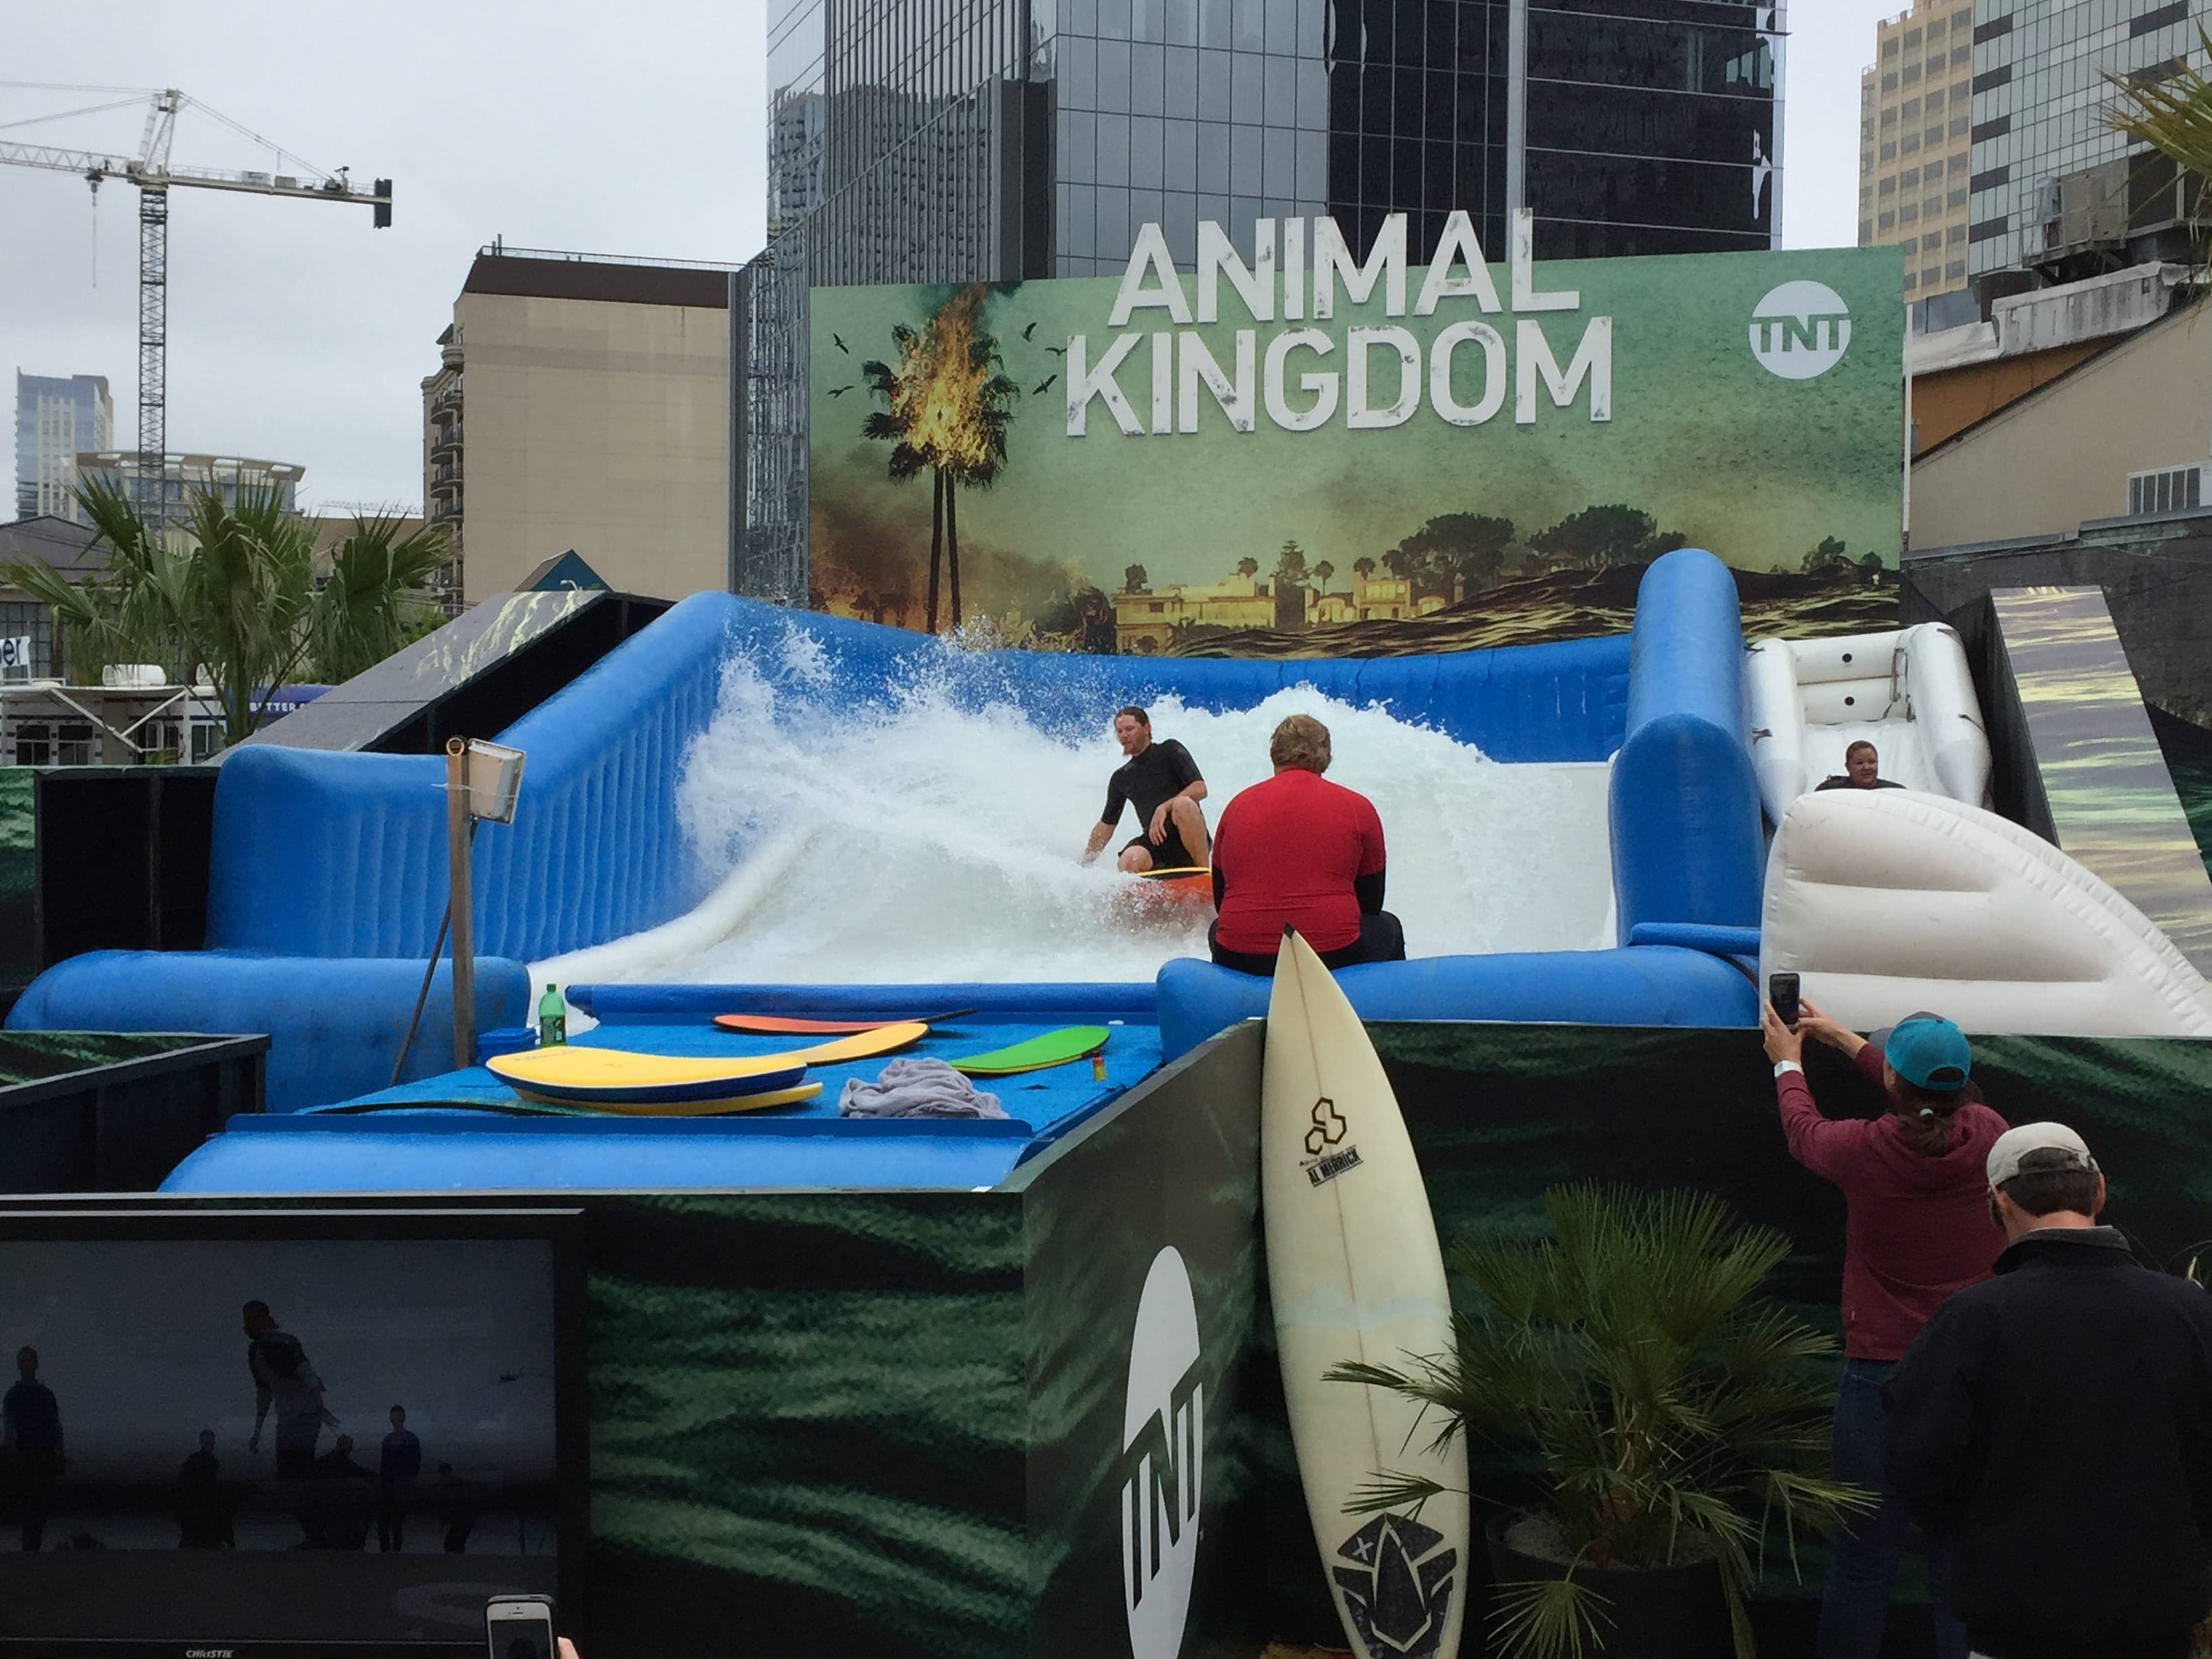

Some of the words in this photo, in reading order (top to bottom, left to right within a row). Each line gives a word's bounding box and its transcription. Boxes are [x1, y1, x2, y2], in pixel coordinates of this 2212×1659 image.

[1108, 207, 1580, 327] ANIMAL
[1749, 312, 1851, 353] TNT
[1066, 316, 1612, 437] KINGDOM
[0, 637, 21, 666] er
[249, 701, 296, 712] BTTER
[1308, 1168, 1321, 1185] AL
[1122, 1355, 1204, 1612] TNT
[185, 1650, 234, 1658] CHRISTIE
